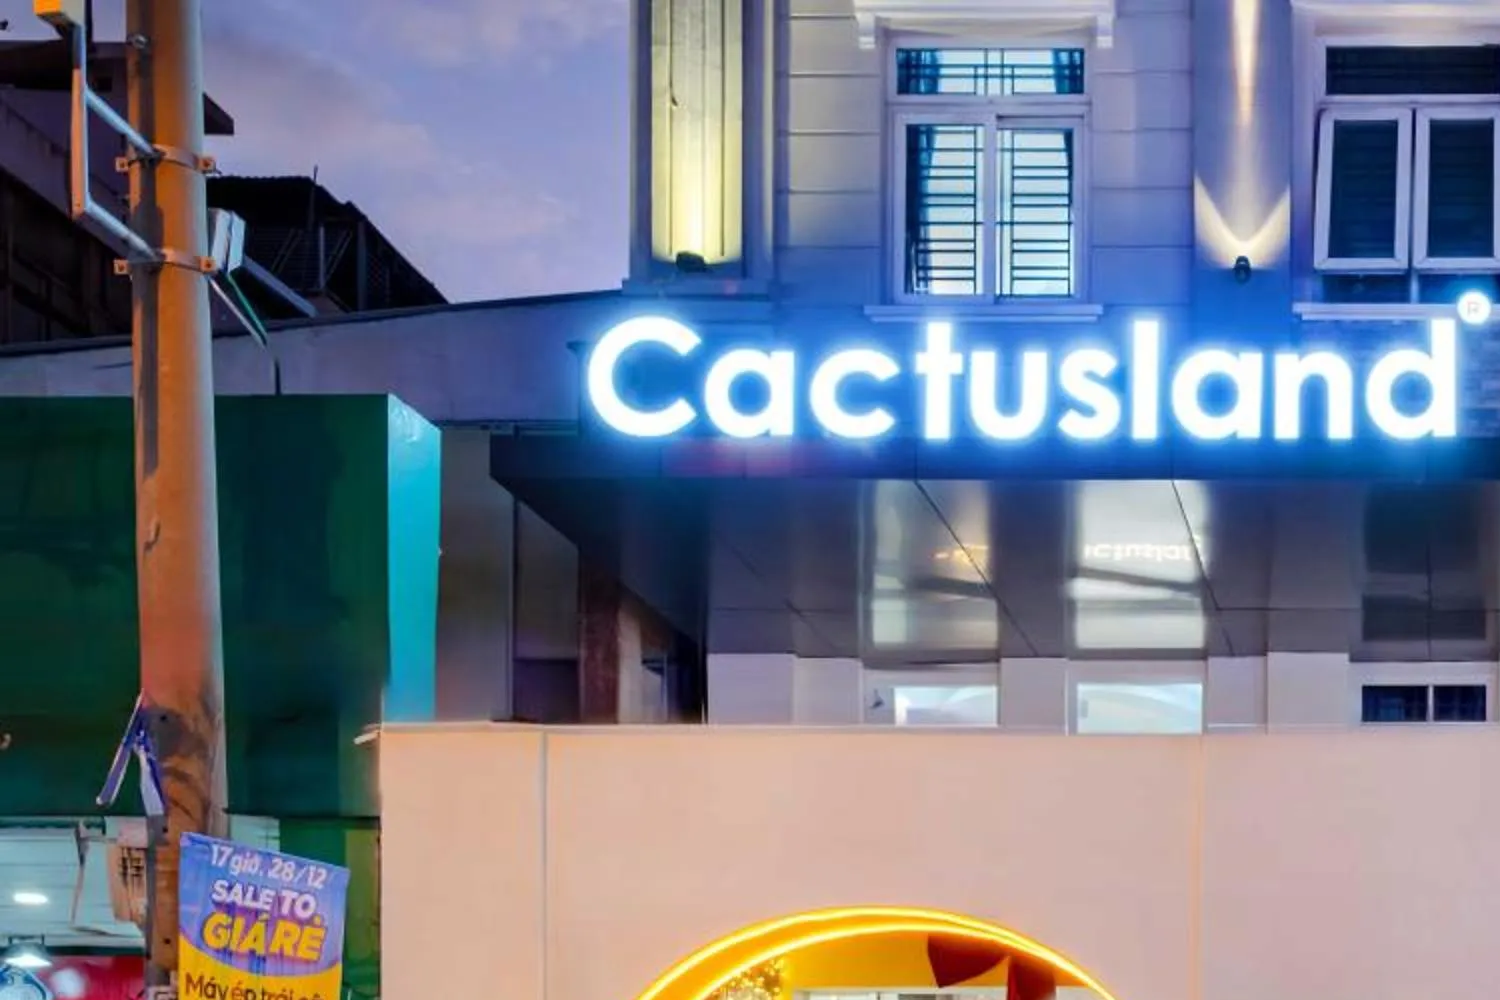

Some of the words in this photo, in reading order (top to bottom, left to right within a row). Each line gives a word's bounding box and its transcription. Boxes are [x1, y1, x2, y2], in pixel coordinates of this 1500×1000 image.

[587, 316, 1459, 441] Cactusland
[211, 843, 234, 868] 17
[267, 857, 328, 890] 28/12
[211, 879, 277, 912] SALE
[280, 889, 317, 919] TO
[203, 911, 267, 956] GIÁ
